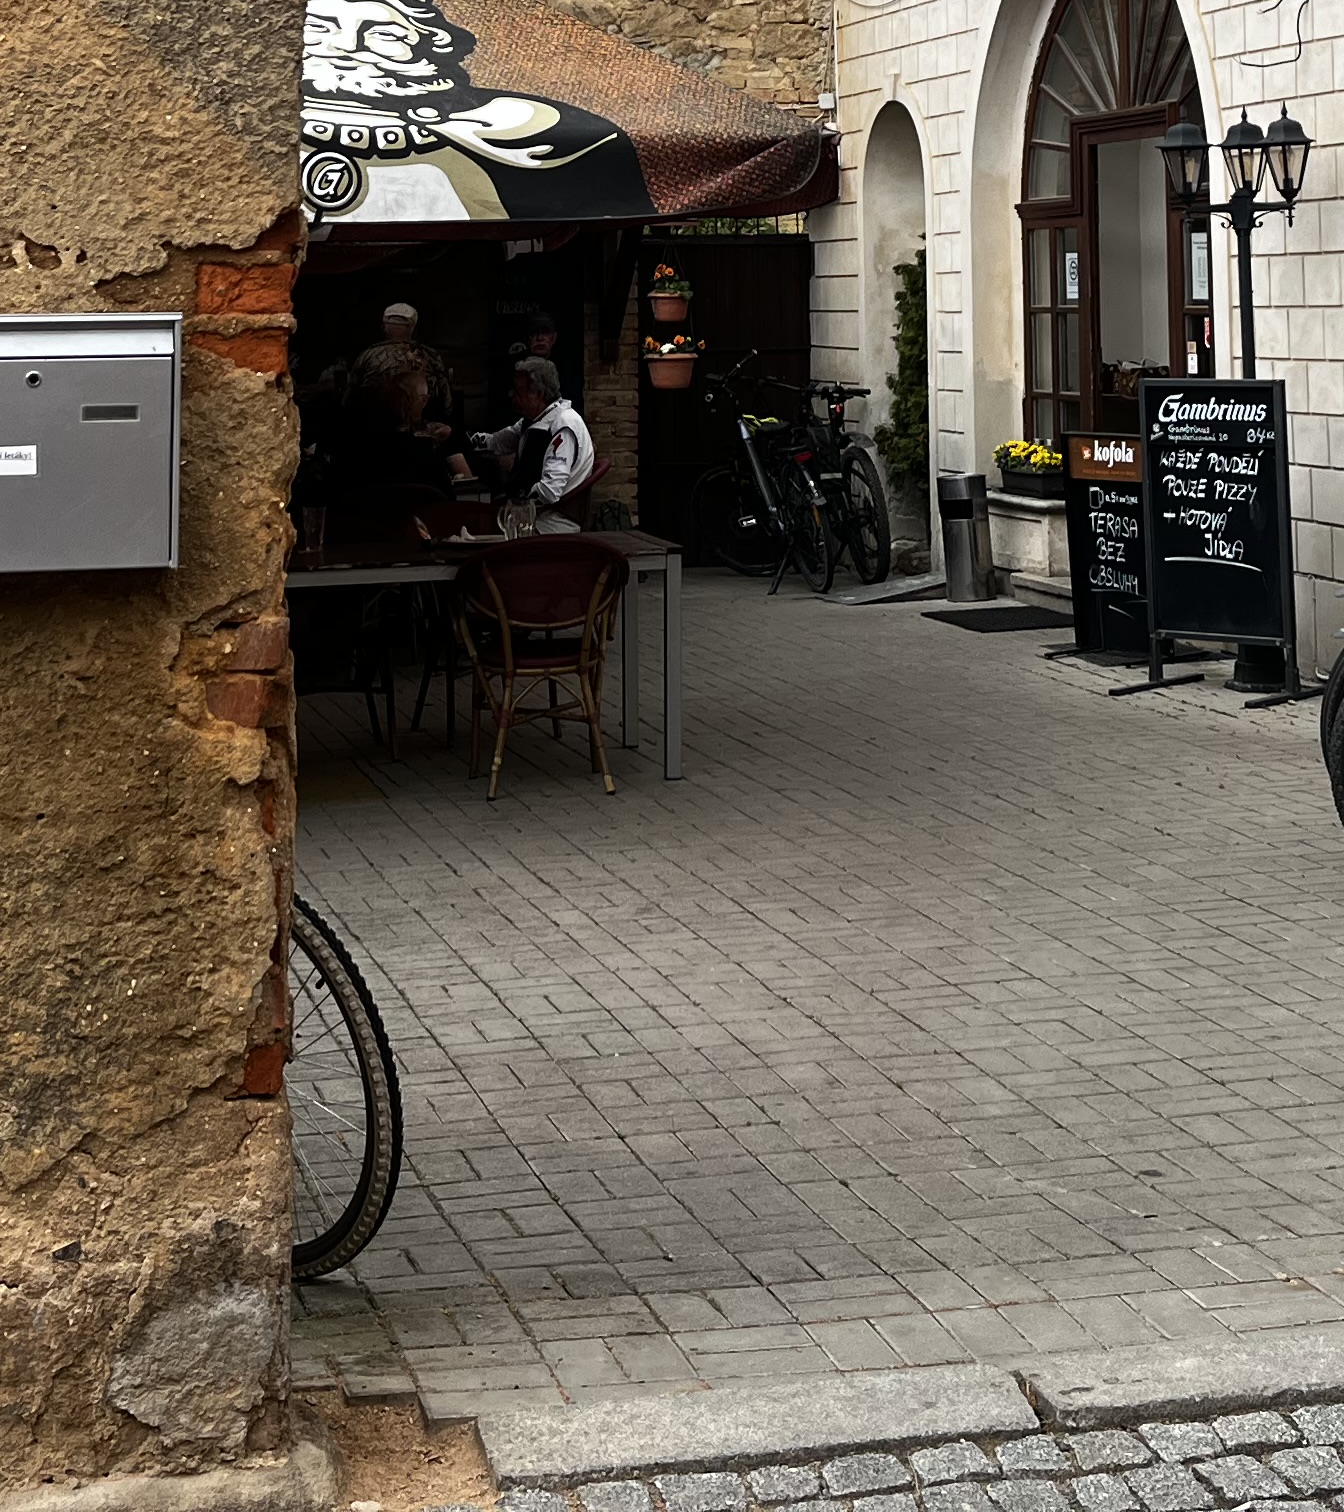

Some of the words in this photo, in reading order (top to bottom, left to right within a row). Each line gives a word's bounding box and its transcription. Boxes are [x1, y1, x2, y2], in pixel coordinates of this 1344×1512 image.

[1158, 392, 1268, 423] Gambrinus
[1093, 439, 1134, 468] kofola
[1162, 474, 1208, 499] POUZE
[1213, 479, 1258, 505] PIZZY
[1088, 511, 1139, 539] TERASA
[1178, 506, 1233, 531] HOTOVÁ
[1096, 536, 1126, 563] BEZ
[1204, 531, 1244, 561] JÍDLA
